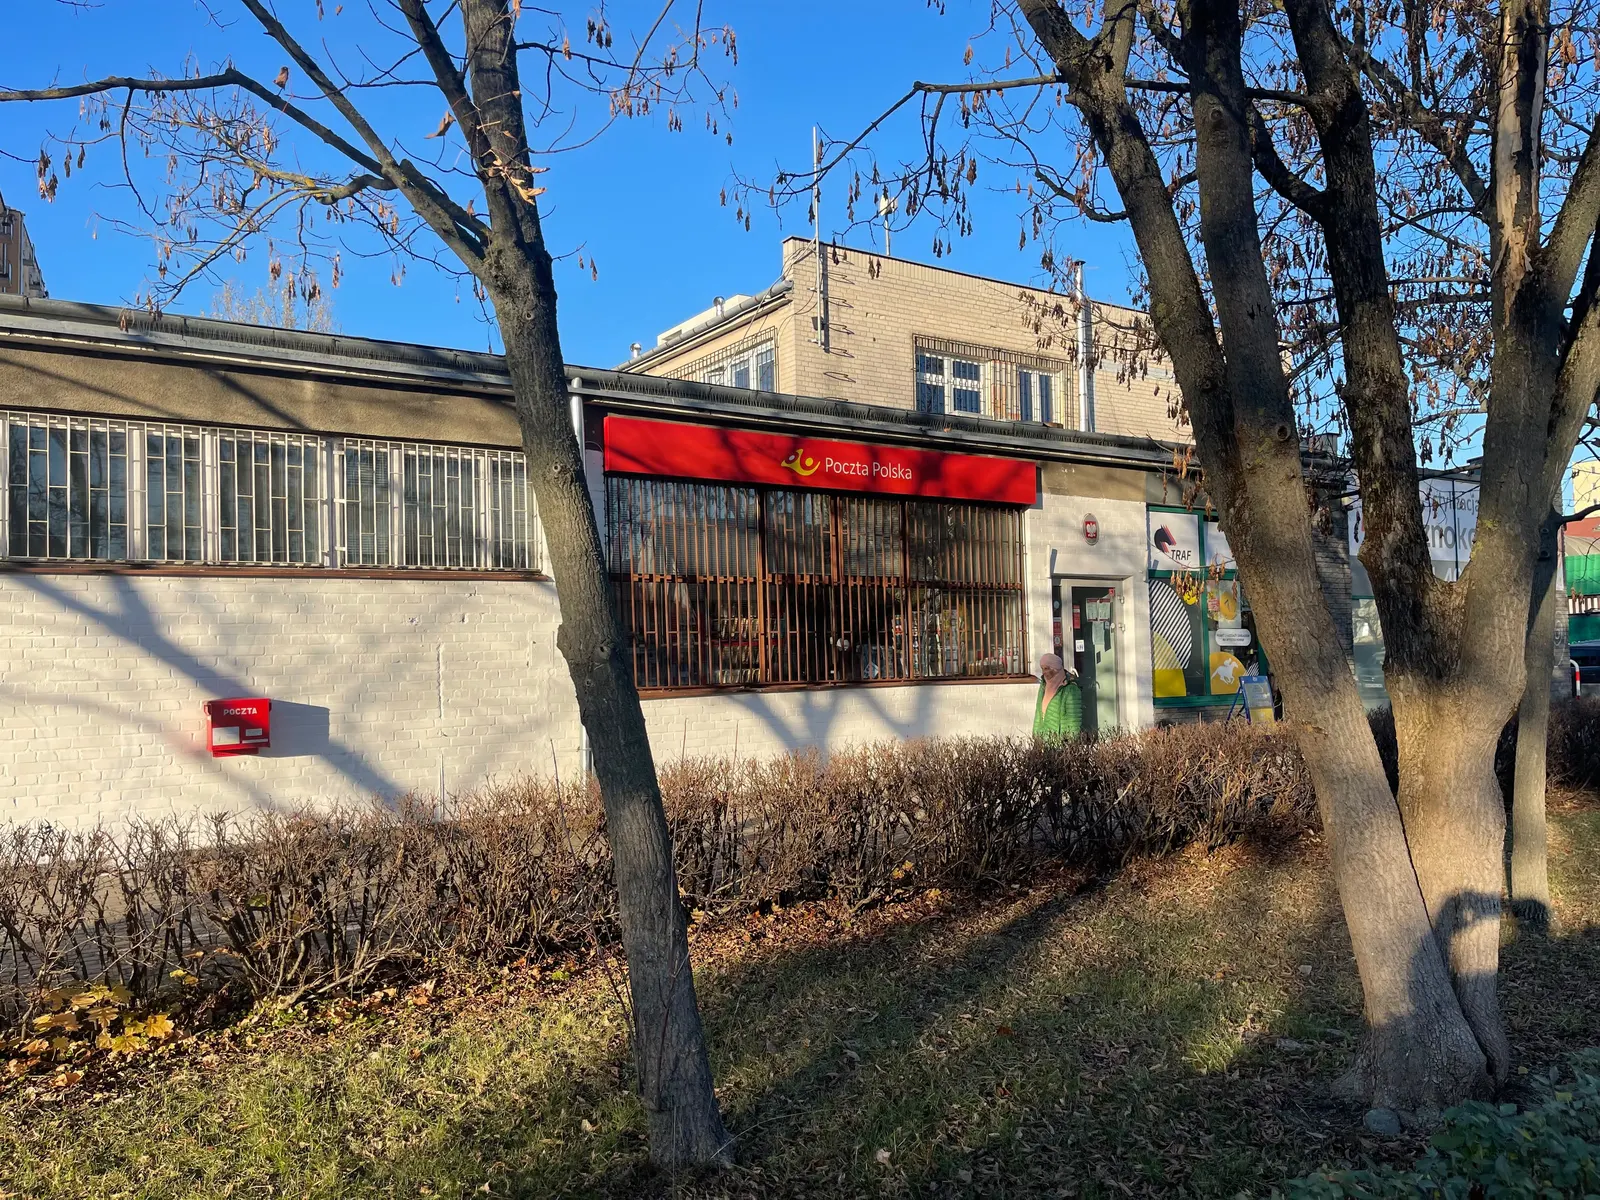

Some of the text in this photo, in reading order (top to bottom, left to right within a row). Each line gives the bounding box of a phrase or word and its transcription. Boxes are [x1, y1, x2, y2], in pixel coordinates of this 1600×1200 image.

[825, 457, 913, 480] Poczta Polska
[1171, 549, 1192, 561] TRAF
[223, 707, 258, 716] POCZTA
